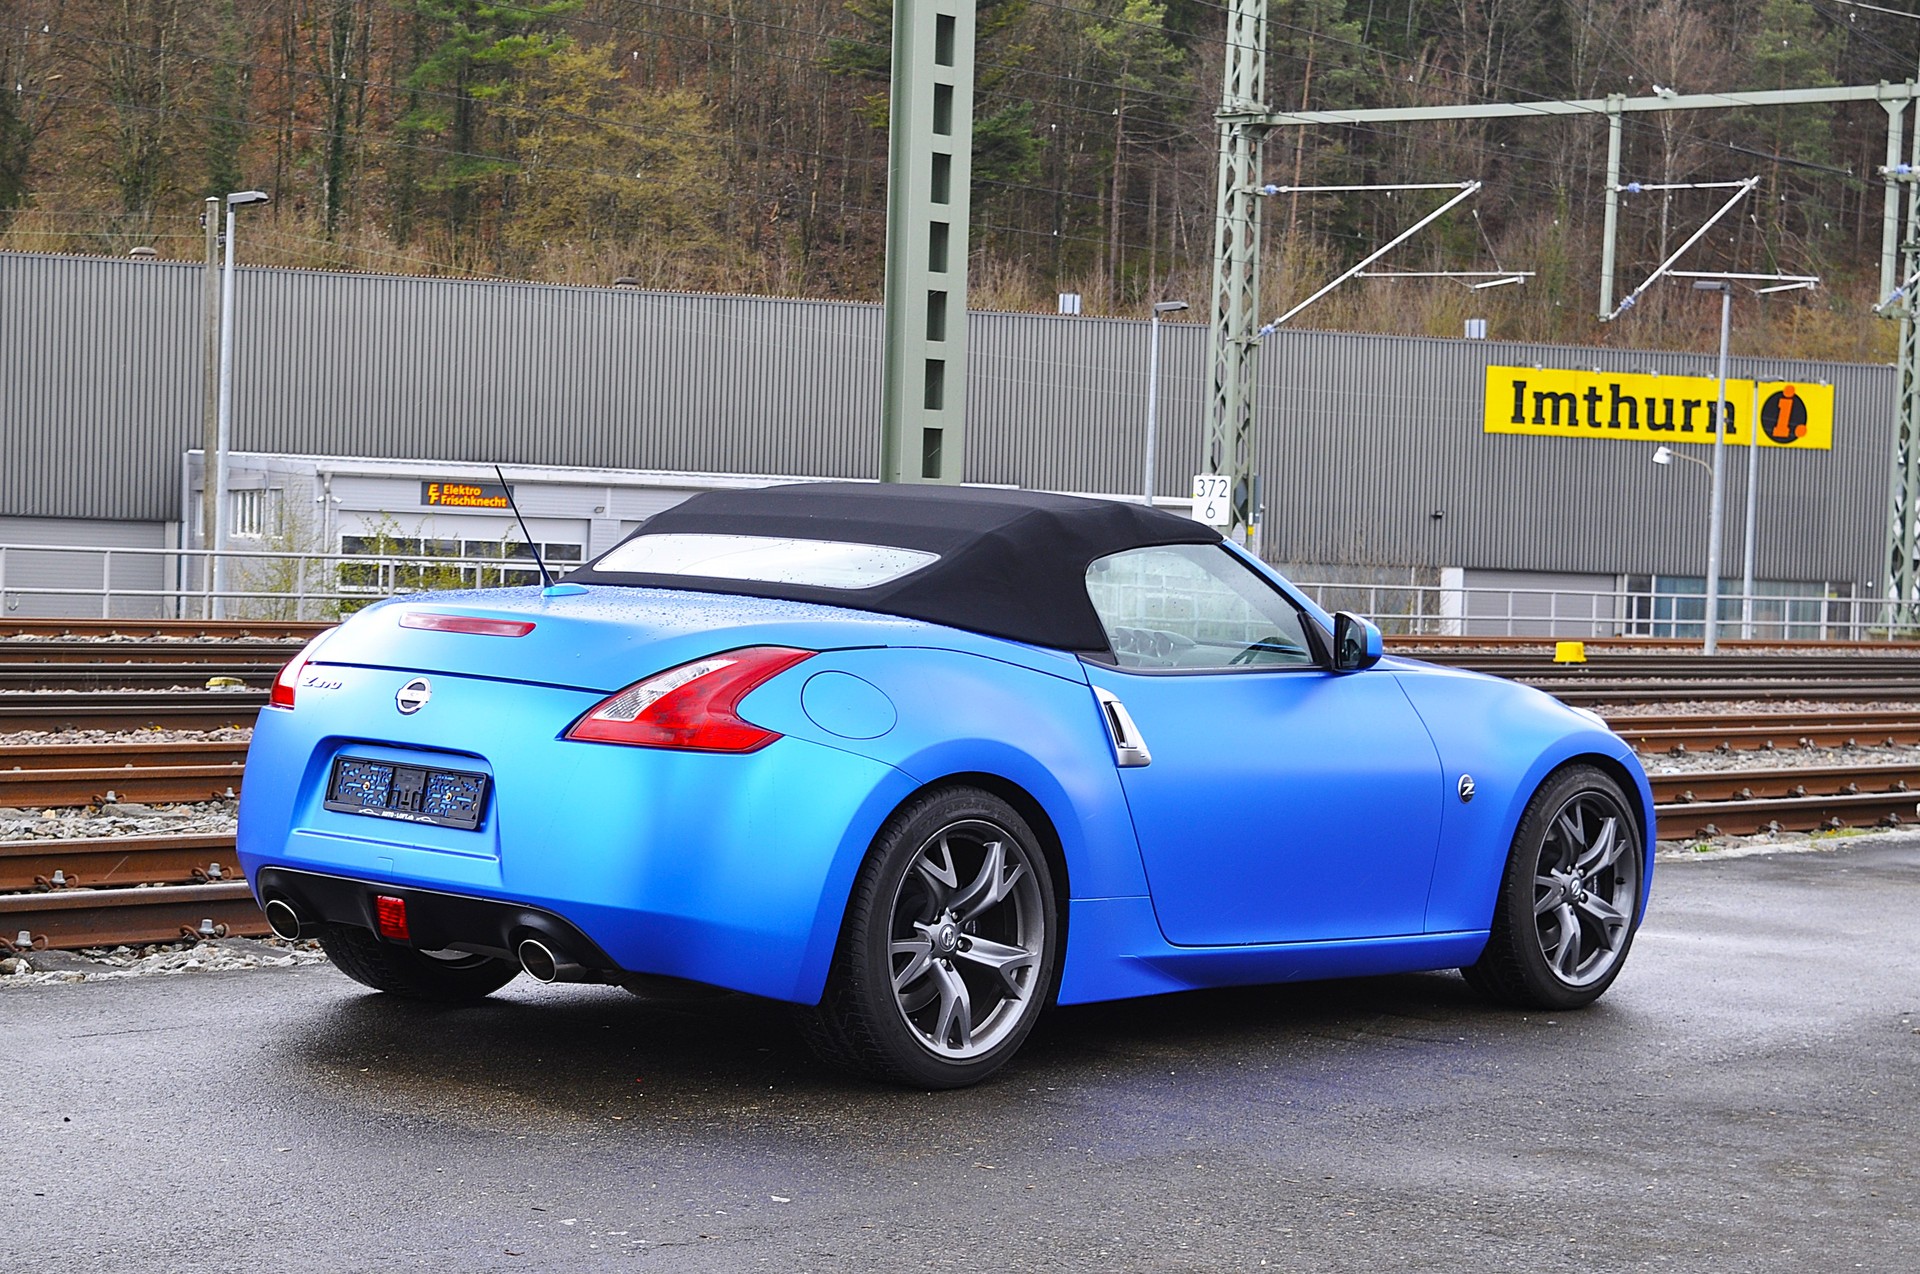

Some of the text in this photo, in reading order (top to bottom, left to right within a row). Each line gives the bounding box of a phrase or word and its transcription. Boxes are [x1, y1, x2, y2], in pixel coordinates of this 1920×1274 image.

[1510, 380, 1737, 435] Imthurn
[443, 484, 482, 496] Elektro
[1196, 479, 1228, 498] 372
[440, 495, 507, 507] Frischknecht
[1205, 501, 1216, 519] 6
